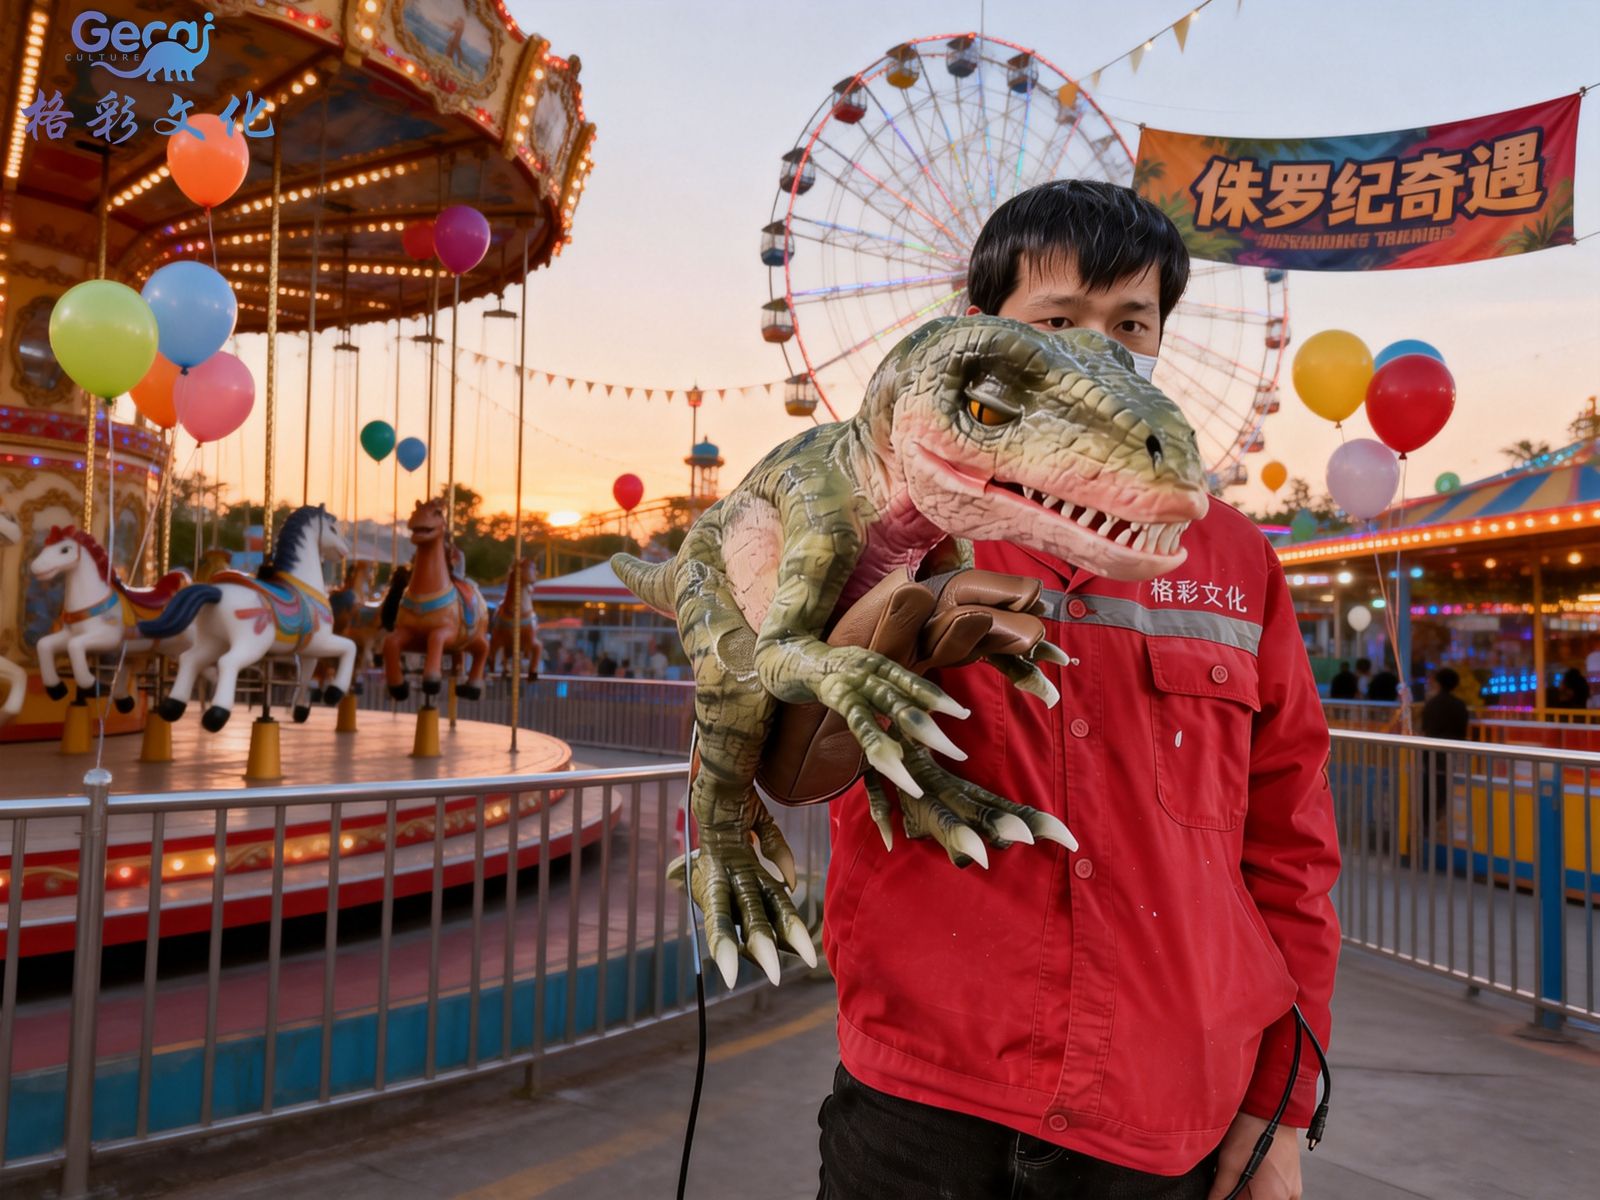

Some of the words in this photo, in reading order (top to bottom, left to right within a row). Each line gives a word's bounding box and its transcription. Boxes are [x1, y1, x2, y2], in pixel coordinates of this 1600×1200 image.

[1195, 131, 1541, 228] 侏罗纪奇遇
[1150, 578, 1247, 612] 格彩文化
